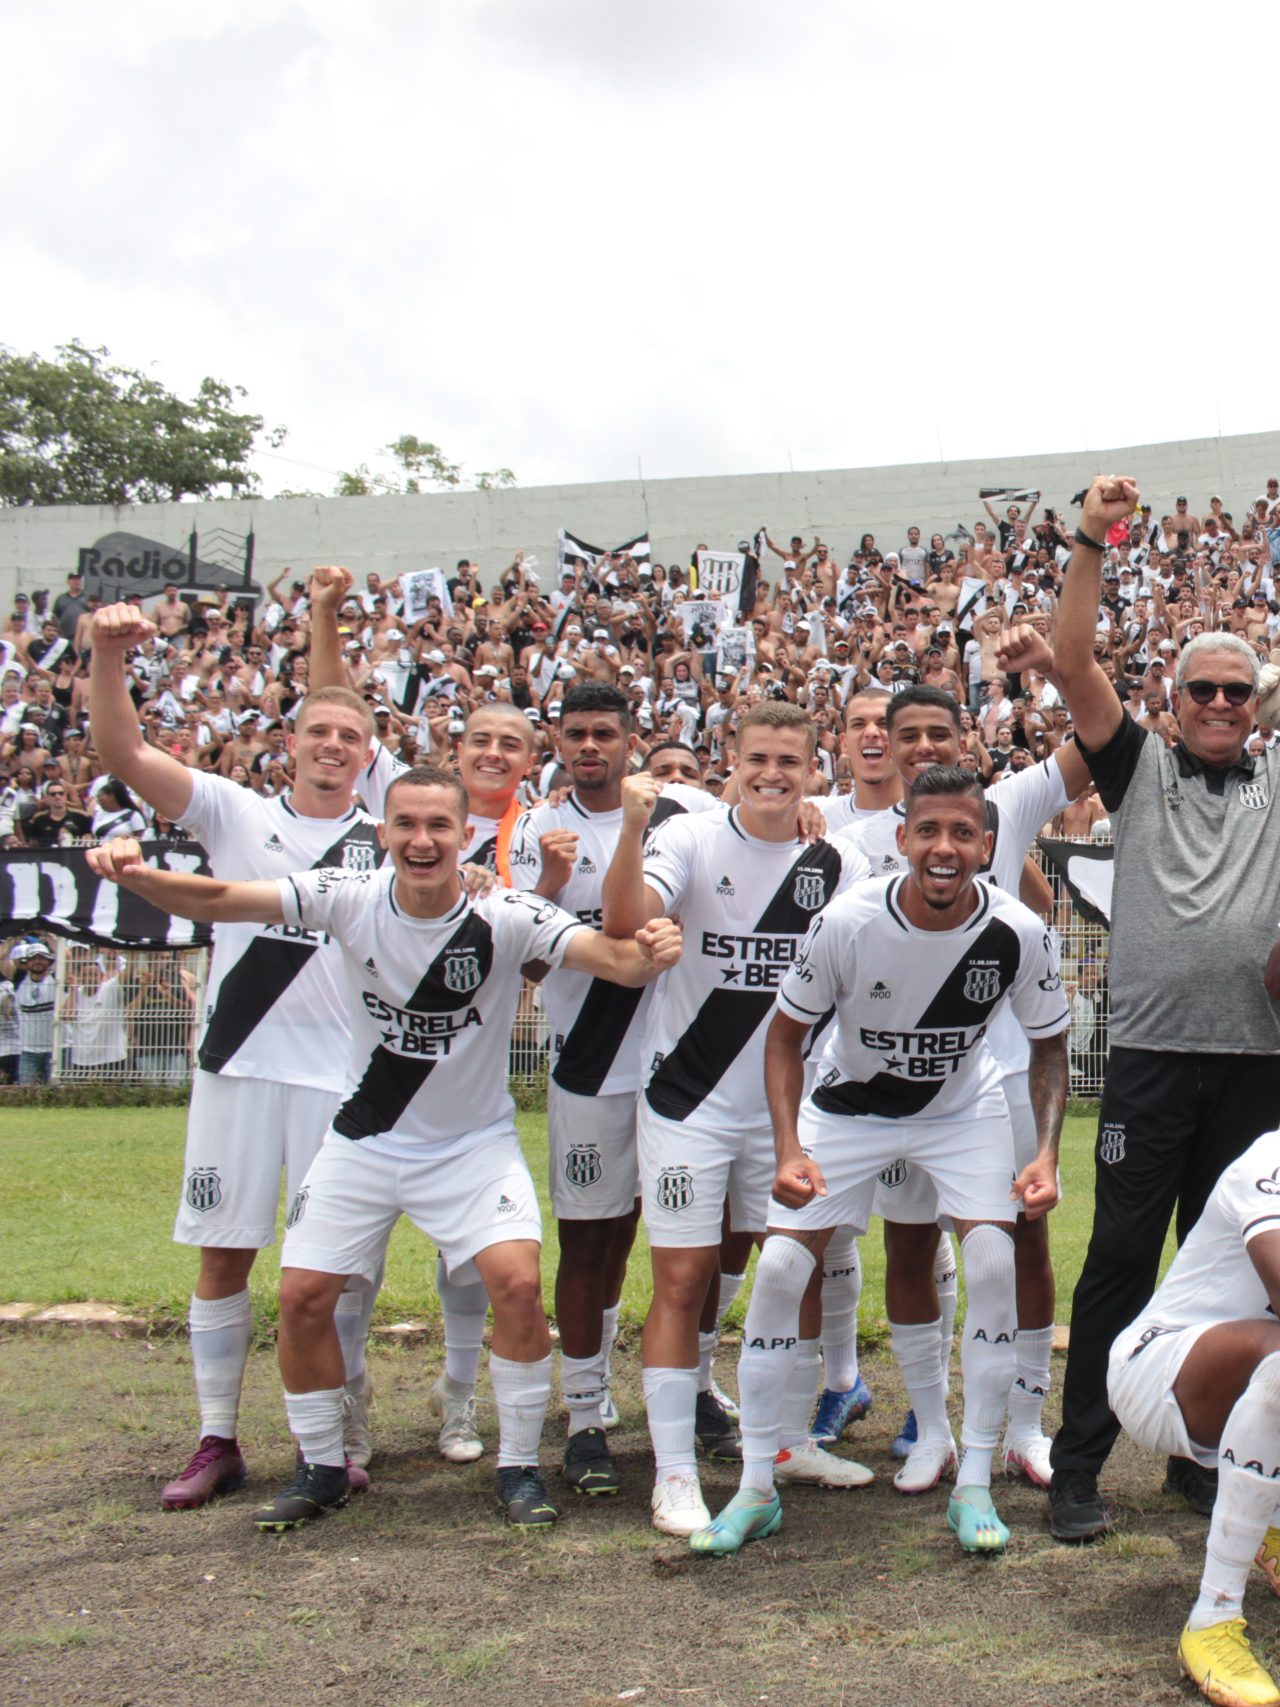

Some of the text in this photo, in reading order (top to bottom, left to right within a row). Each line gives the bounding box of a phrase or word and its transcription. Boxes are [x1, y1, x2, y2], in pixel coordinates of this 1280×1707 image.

[78, 548, 186, 580] Rádio
[264, 842, 283, 853] 1900
[578, 866, 597, 875] 1900
[882, 861, 900, 872] 1900
[716, 886, 736, 897] 1900
[702, 931, 798, 962] ESTREL
[870, 990, 892, 1000] 1900
[363, 991, 484, 1034] ESTRELA
[400, 1032, 457, 1056] BET
[859, 1024, 988, 1055] ESTRELA
[908, 1053, 967, 1078] BET
[497, 1204, 517, 1214] 1900
